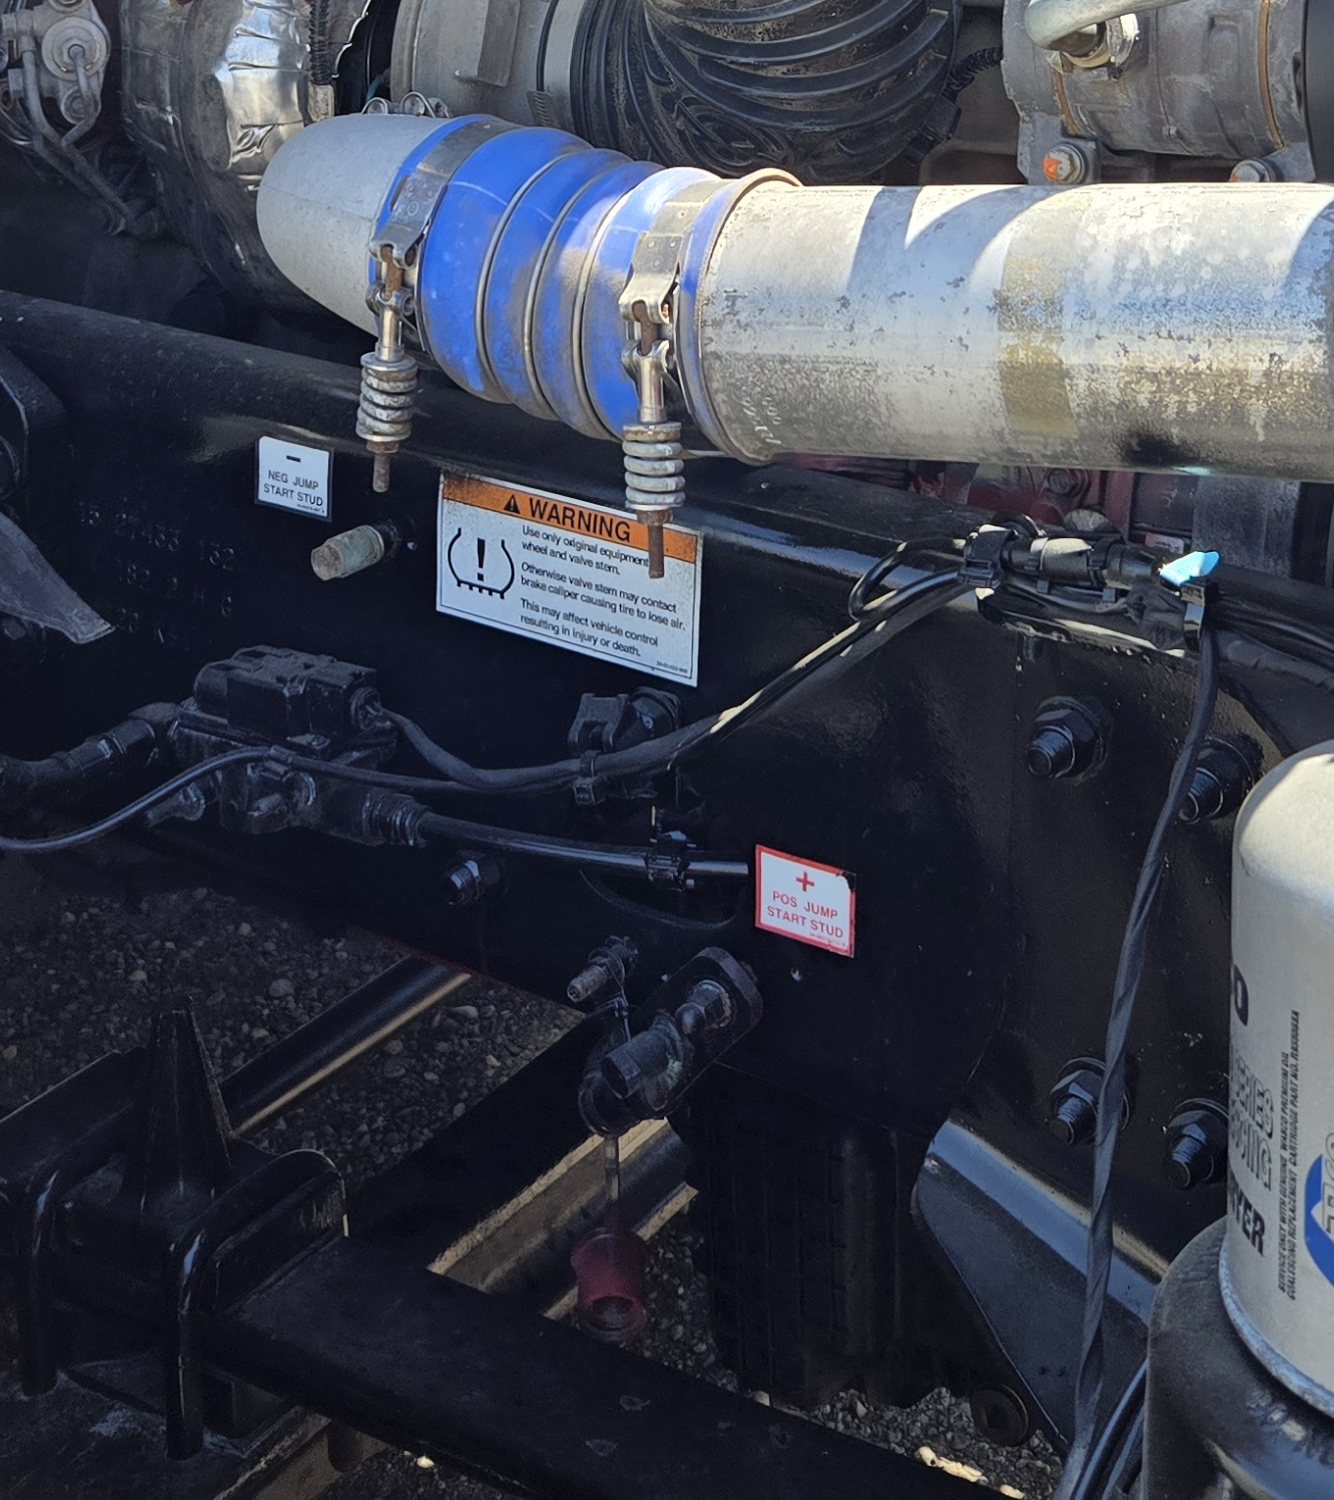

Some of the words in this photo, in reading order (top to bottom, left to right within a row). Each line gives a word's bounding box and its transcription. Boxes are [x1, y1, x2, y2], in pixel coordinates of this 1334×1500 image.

[263, 483, 295, 499] START
[297, 492, 323, 507] STUD
[268, 469, 288, 484] NEG
[292, 477, 319, 491] JUMP
[529, 497, 631, 543] WARNING
[522, 525, 540, 539] Use
[541, 531, 561, 546] only
[564, 535, 598, 555] original
[600, 546, 649, 568] equipment
[522, 541, 547, 556] wheel
[550, 547, 567, 560] and
[569, 553, 593, 568] valve
[595, 561, 621, 576] stem.
[521, 561, 566, 583] Otherwise
[569, 572, 593, 590] valve
[595, 581, 617, 597] stem
[619, 589, 640, 605] may
[641, 594, 677, 614] contact
[521, 576, 547, 592] brake
[548, 583, 579, 603] caliper
[580, 593, 617, 613] causing
[619, 602, 635, 616] tire
[636, 607, 647, 619] to
[649, 610, 669, 625] lose
[670, 617, 686, 631] air.
[520, 598, 540, 612] This
[542, 604, 561, 620] may
[563, 608, 589, 626] affect
[590, 617, 624, 638] vehicle
[625, 627, 659, 647] control
[520, 615, 560, 635] resulting
[561, 624, 570, 636] in
[572, 627, 598, 646] injury
[600, 637, 610, 647] or
[612, 641, 641, 657] death.
[767, 905, 807, 927] START
[810, 919, 844, 938] STUD
[772, 891, 797, 908] POS
[804, 901, 838, 919] JUMP
[1281, 1069, 1289, 1116] PREMIUM
[1290, 1081, 1298, 1109] PART
[1280, 1115, 1288, 1151] WABCO
[1289, 1110, 1298, 1167] CARTRIDGE
[1279, 1198, 1287, 1225] WITH
[1288, 1169, 1297, 1239] REPLACEMENT
[1287, 1239, 1296, 1300] COALESCING
